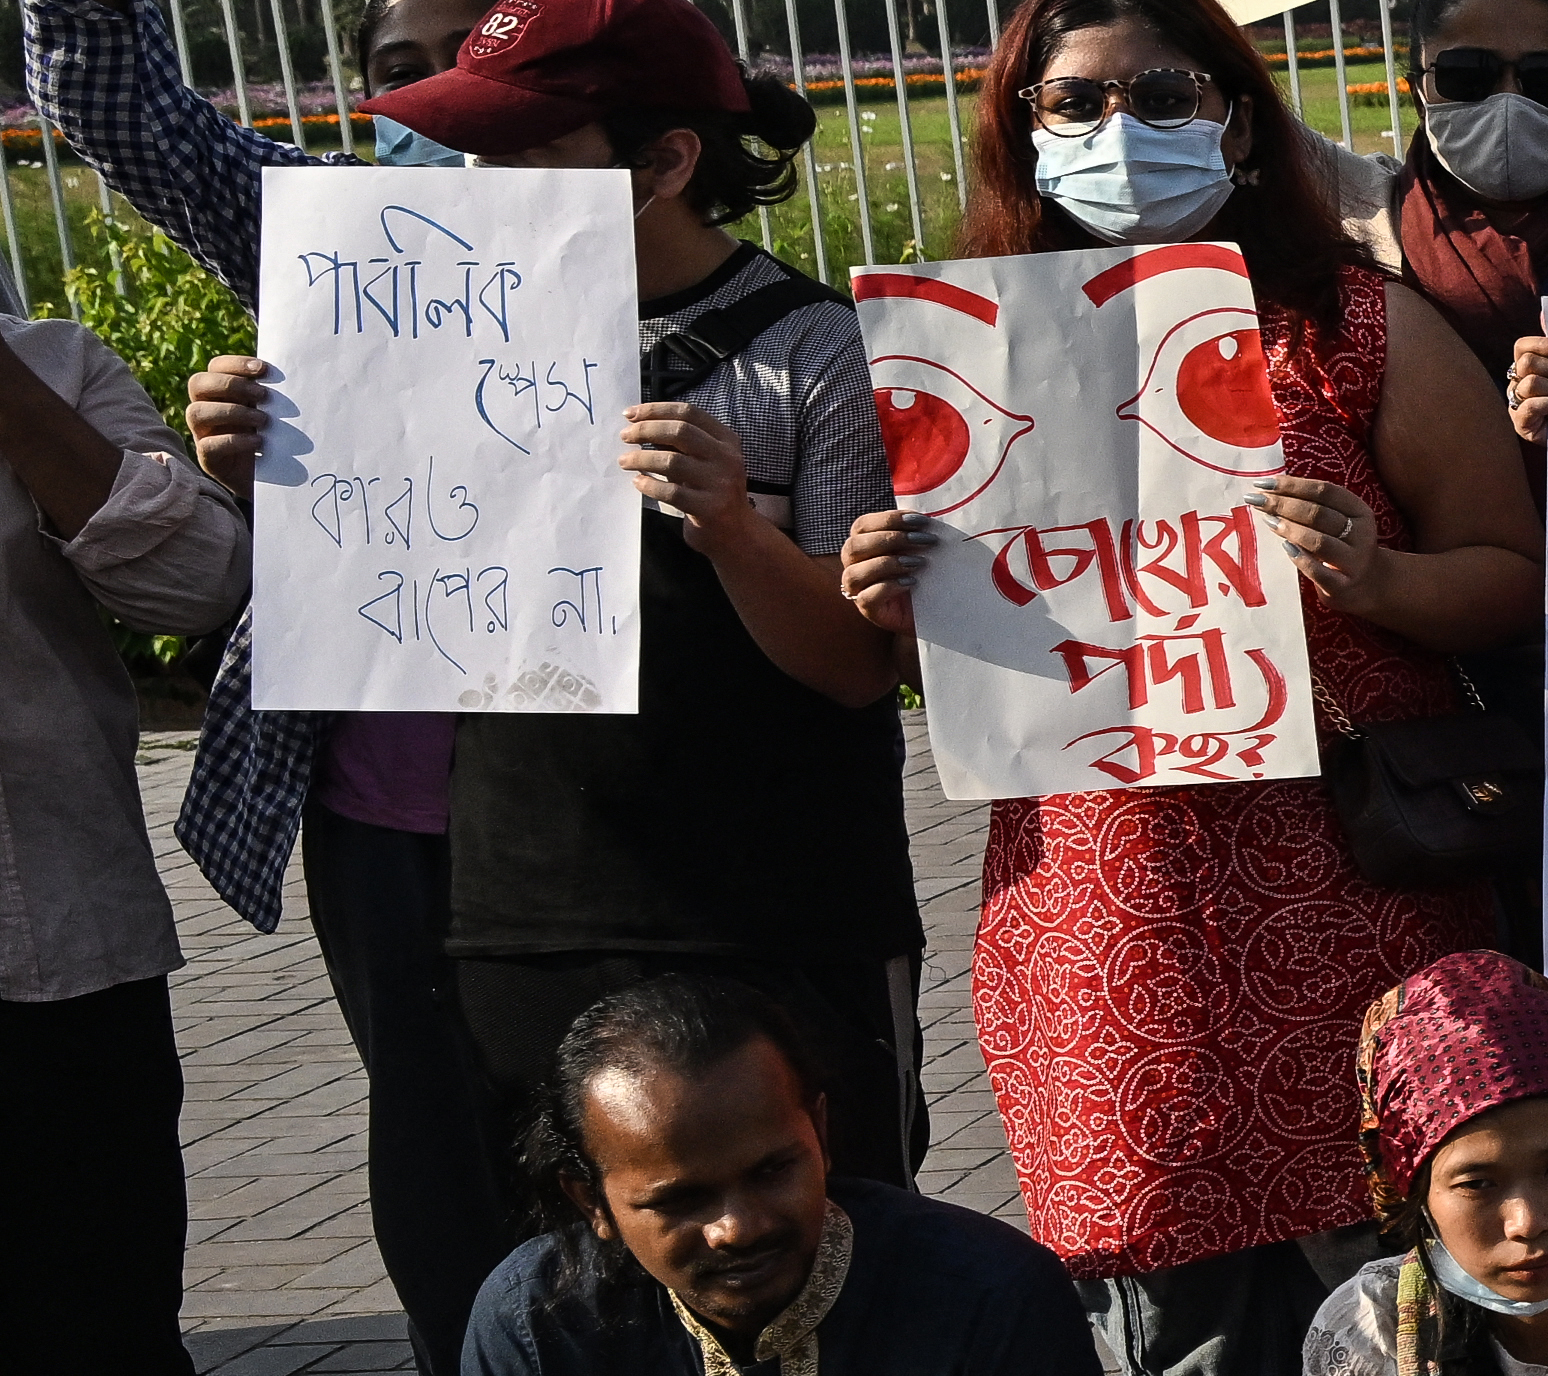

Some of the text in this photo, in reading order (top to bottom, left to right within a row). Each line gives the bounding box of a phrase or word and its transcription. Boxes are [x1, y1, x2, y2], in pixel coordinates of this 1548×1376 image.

[482, 13, 519, 39] 82
[298, 205, 523, 342] পাবলিক
[475, 358, 598, 456] স্পেস
[310, 455, 480, 551] কারও
[963, 505, 1268, 622] চোখের
[358, 565, 511, 675] বাপের
[1049, 613, 1236, 715] পর্দা
